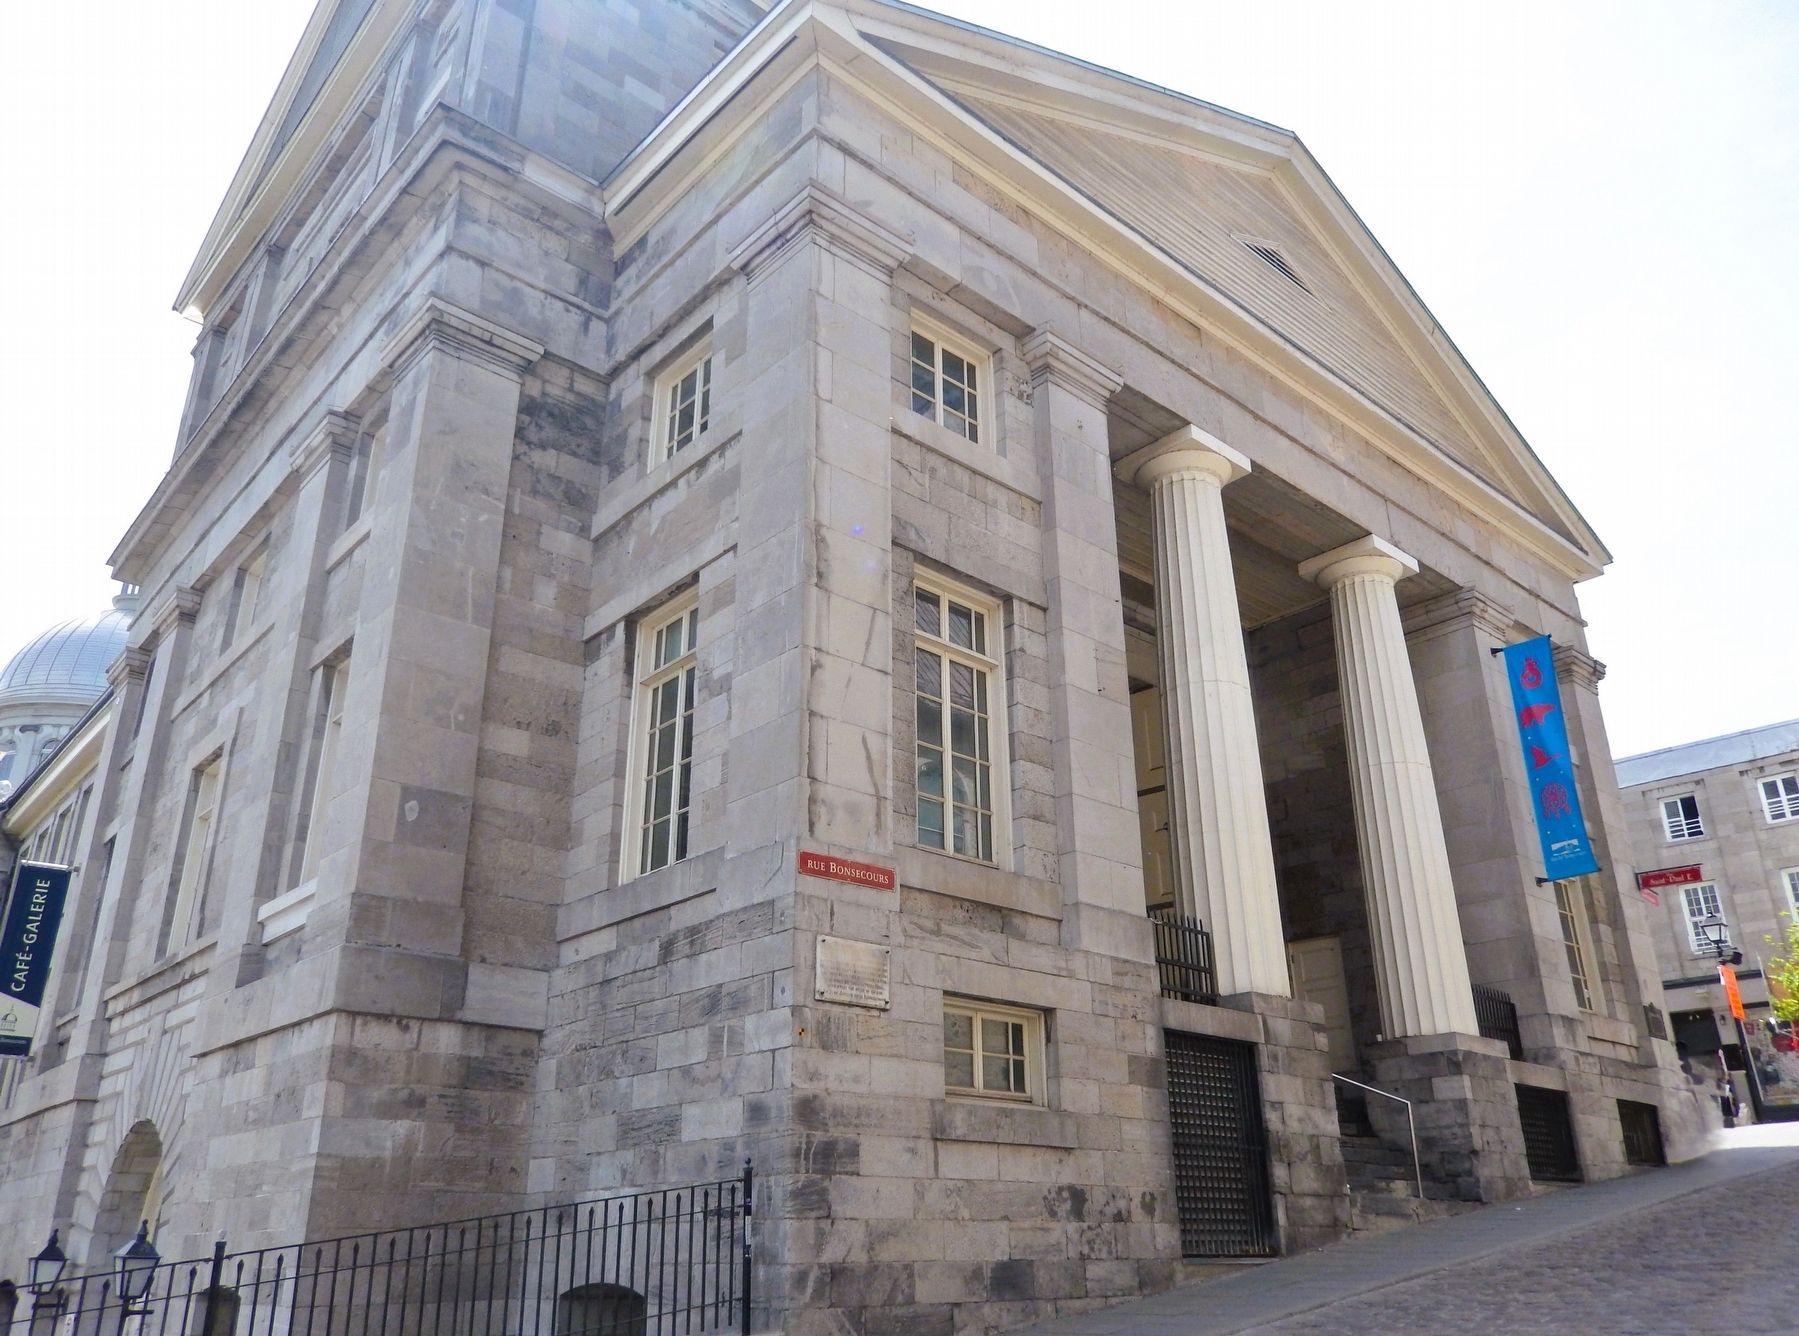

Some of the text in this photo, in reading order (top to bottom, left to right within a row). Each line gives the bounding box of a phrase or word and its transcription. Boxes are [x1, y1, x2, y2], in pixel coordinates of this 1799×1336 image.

[807, 859, 889, 884] RUE BONSECOURS
[10, 879, 51, 992] CAFÉ-GALERIE
